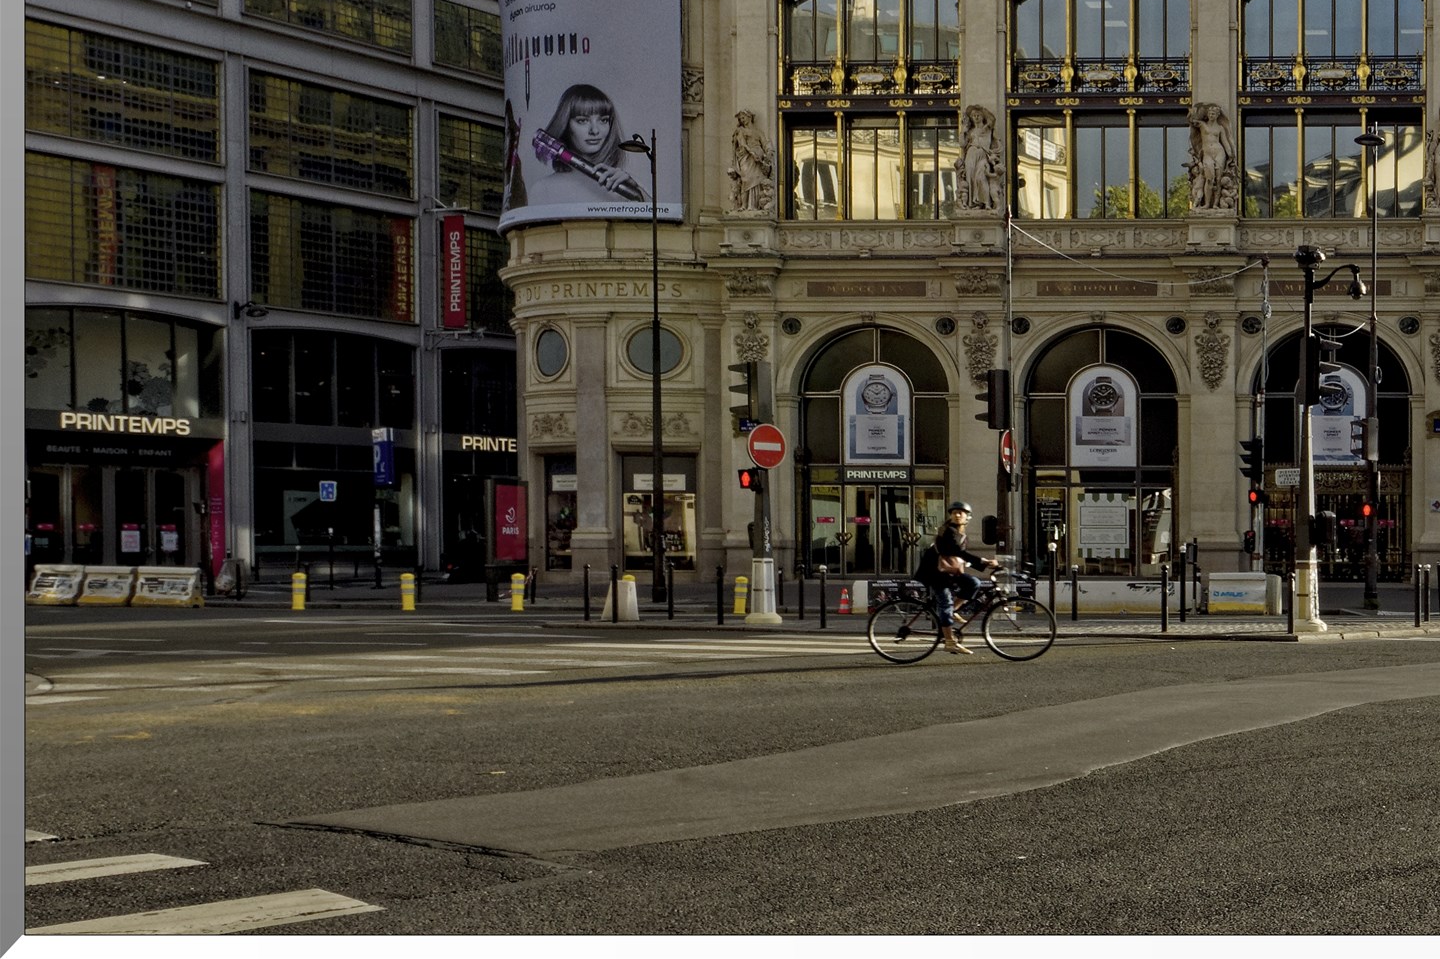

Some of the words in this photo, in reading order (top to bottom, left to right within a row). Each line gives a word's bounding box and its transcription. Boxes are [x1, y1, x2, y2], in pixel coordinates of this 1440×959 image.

[587, 204, 670, 214] www.metropoleme
[449, 231, 461, 312] PRINTEMPS
[60, 411, 191, 436] PRINTEMPS
[462, 435, 518, 452] PRINTE
[847, 470, 907, 479] PRINTEMPS
[502, 526, 520, 536] PARIS
